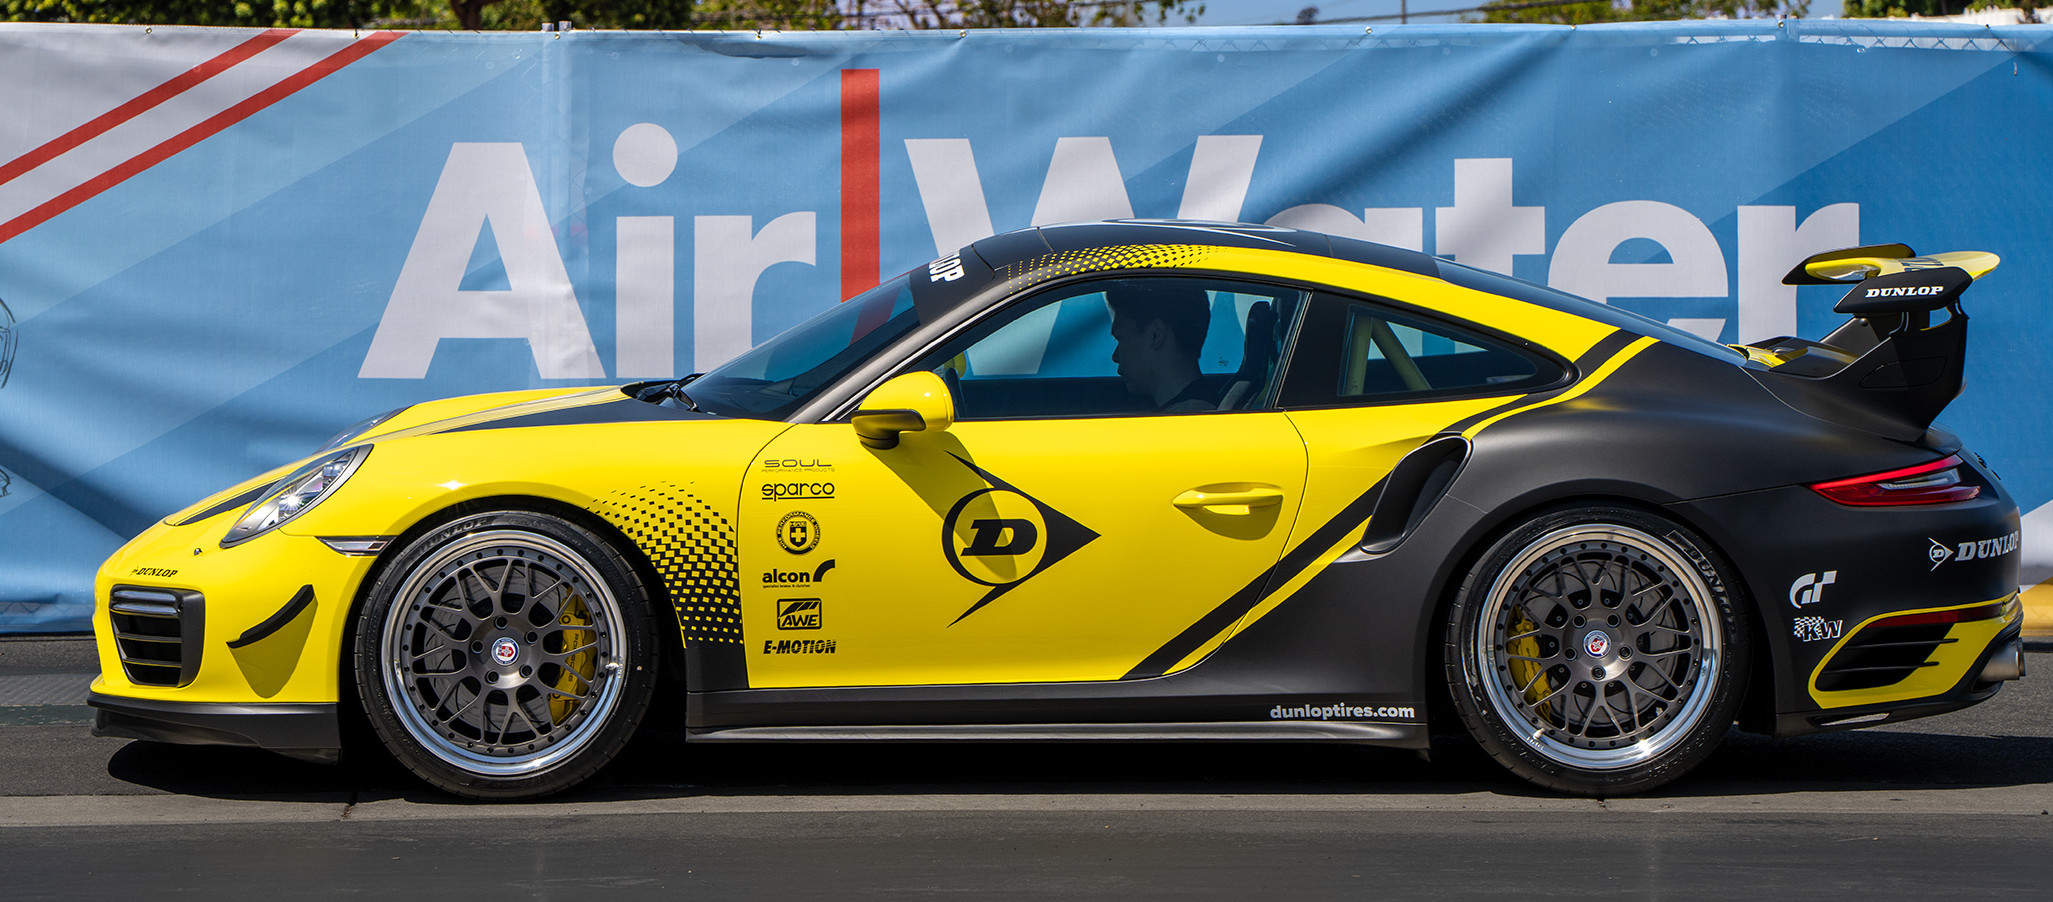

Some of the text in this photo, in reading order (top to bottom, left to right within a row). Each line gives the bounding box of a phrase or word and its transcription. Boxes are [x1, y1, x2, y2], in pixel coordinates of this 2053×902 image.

[357, 122, 1860, 380] Air Wter
[1864, 285, 1945, 299] DUNLOP
[764, 459, 832, 468] SOUL
[761, 482, 835, 501] sparco
[961, 518, 1038, 556] D
[1954, 530, 2019, 561] DUNLOP
[136, 567, 179, 578] DUNLOP
[762, 568, 810, 583] alcon
[781, 614, 819, 627] AWE
[1802, 619, 1844, 642] KW
[763, 639, 837, 655] E-MOTION
[1269, 702, 1416, 720] dunloptires.com
